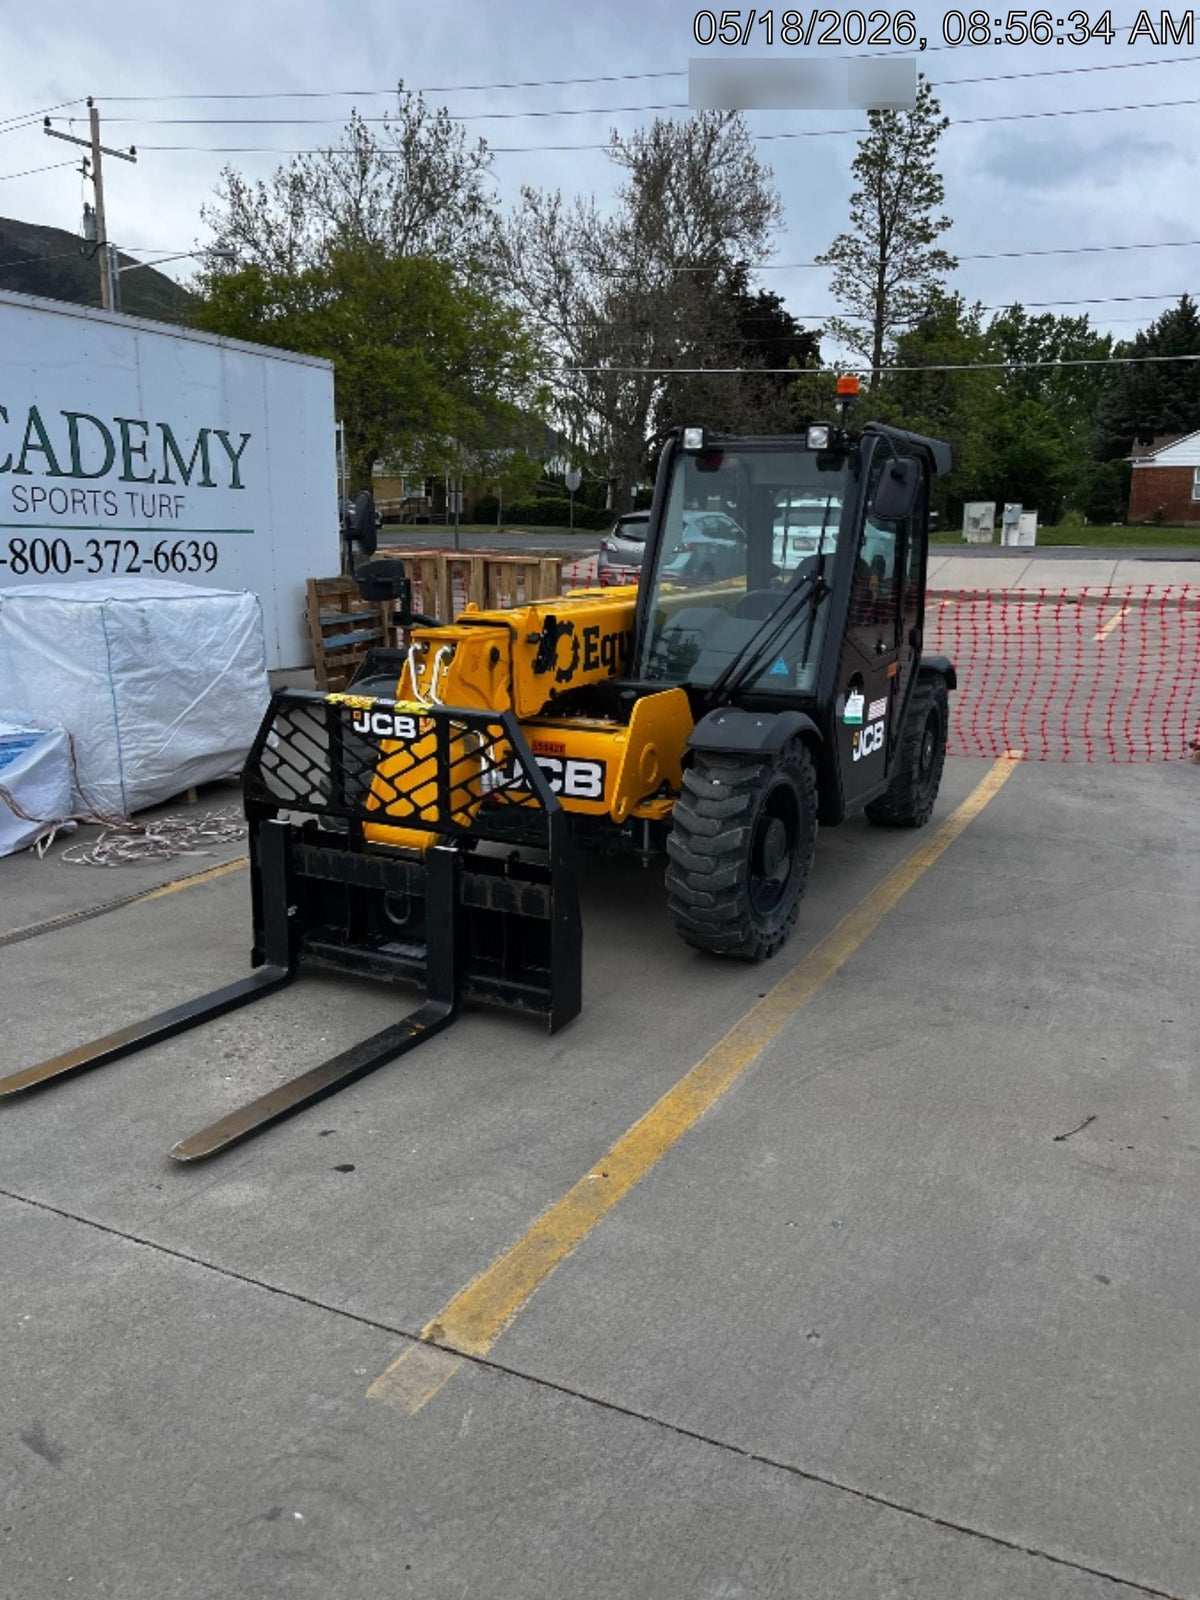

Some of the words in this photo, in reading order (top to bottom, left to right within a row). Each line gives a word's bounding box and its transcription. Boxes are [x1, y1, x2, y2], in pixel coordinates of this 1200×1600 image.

[0, 405, 251, 489] ADEMY
[12, 485, 118, 517] SPORTS
[125, 491, 185, 519] TURF
[353, 712, 416, 738] JCB
[853, 720, 884, 761] JCB
